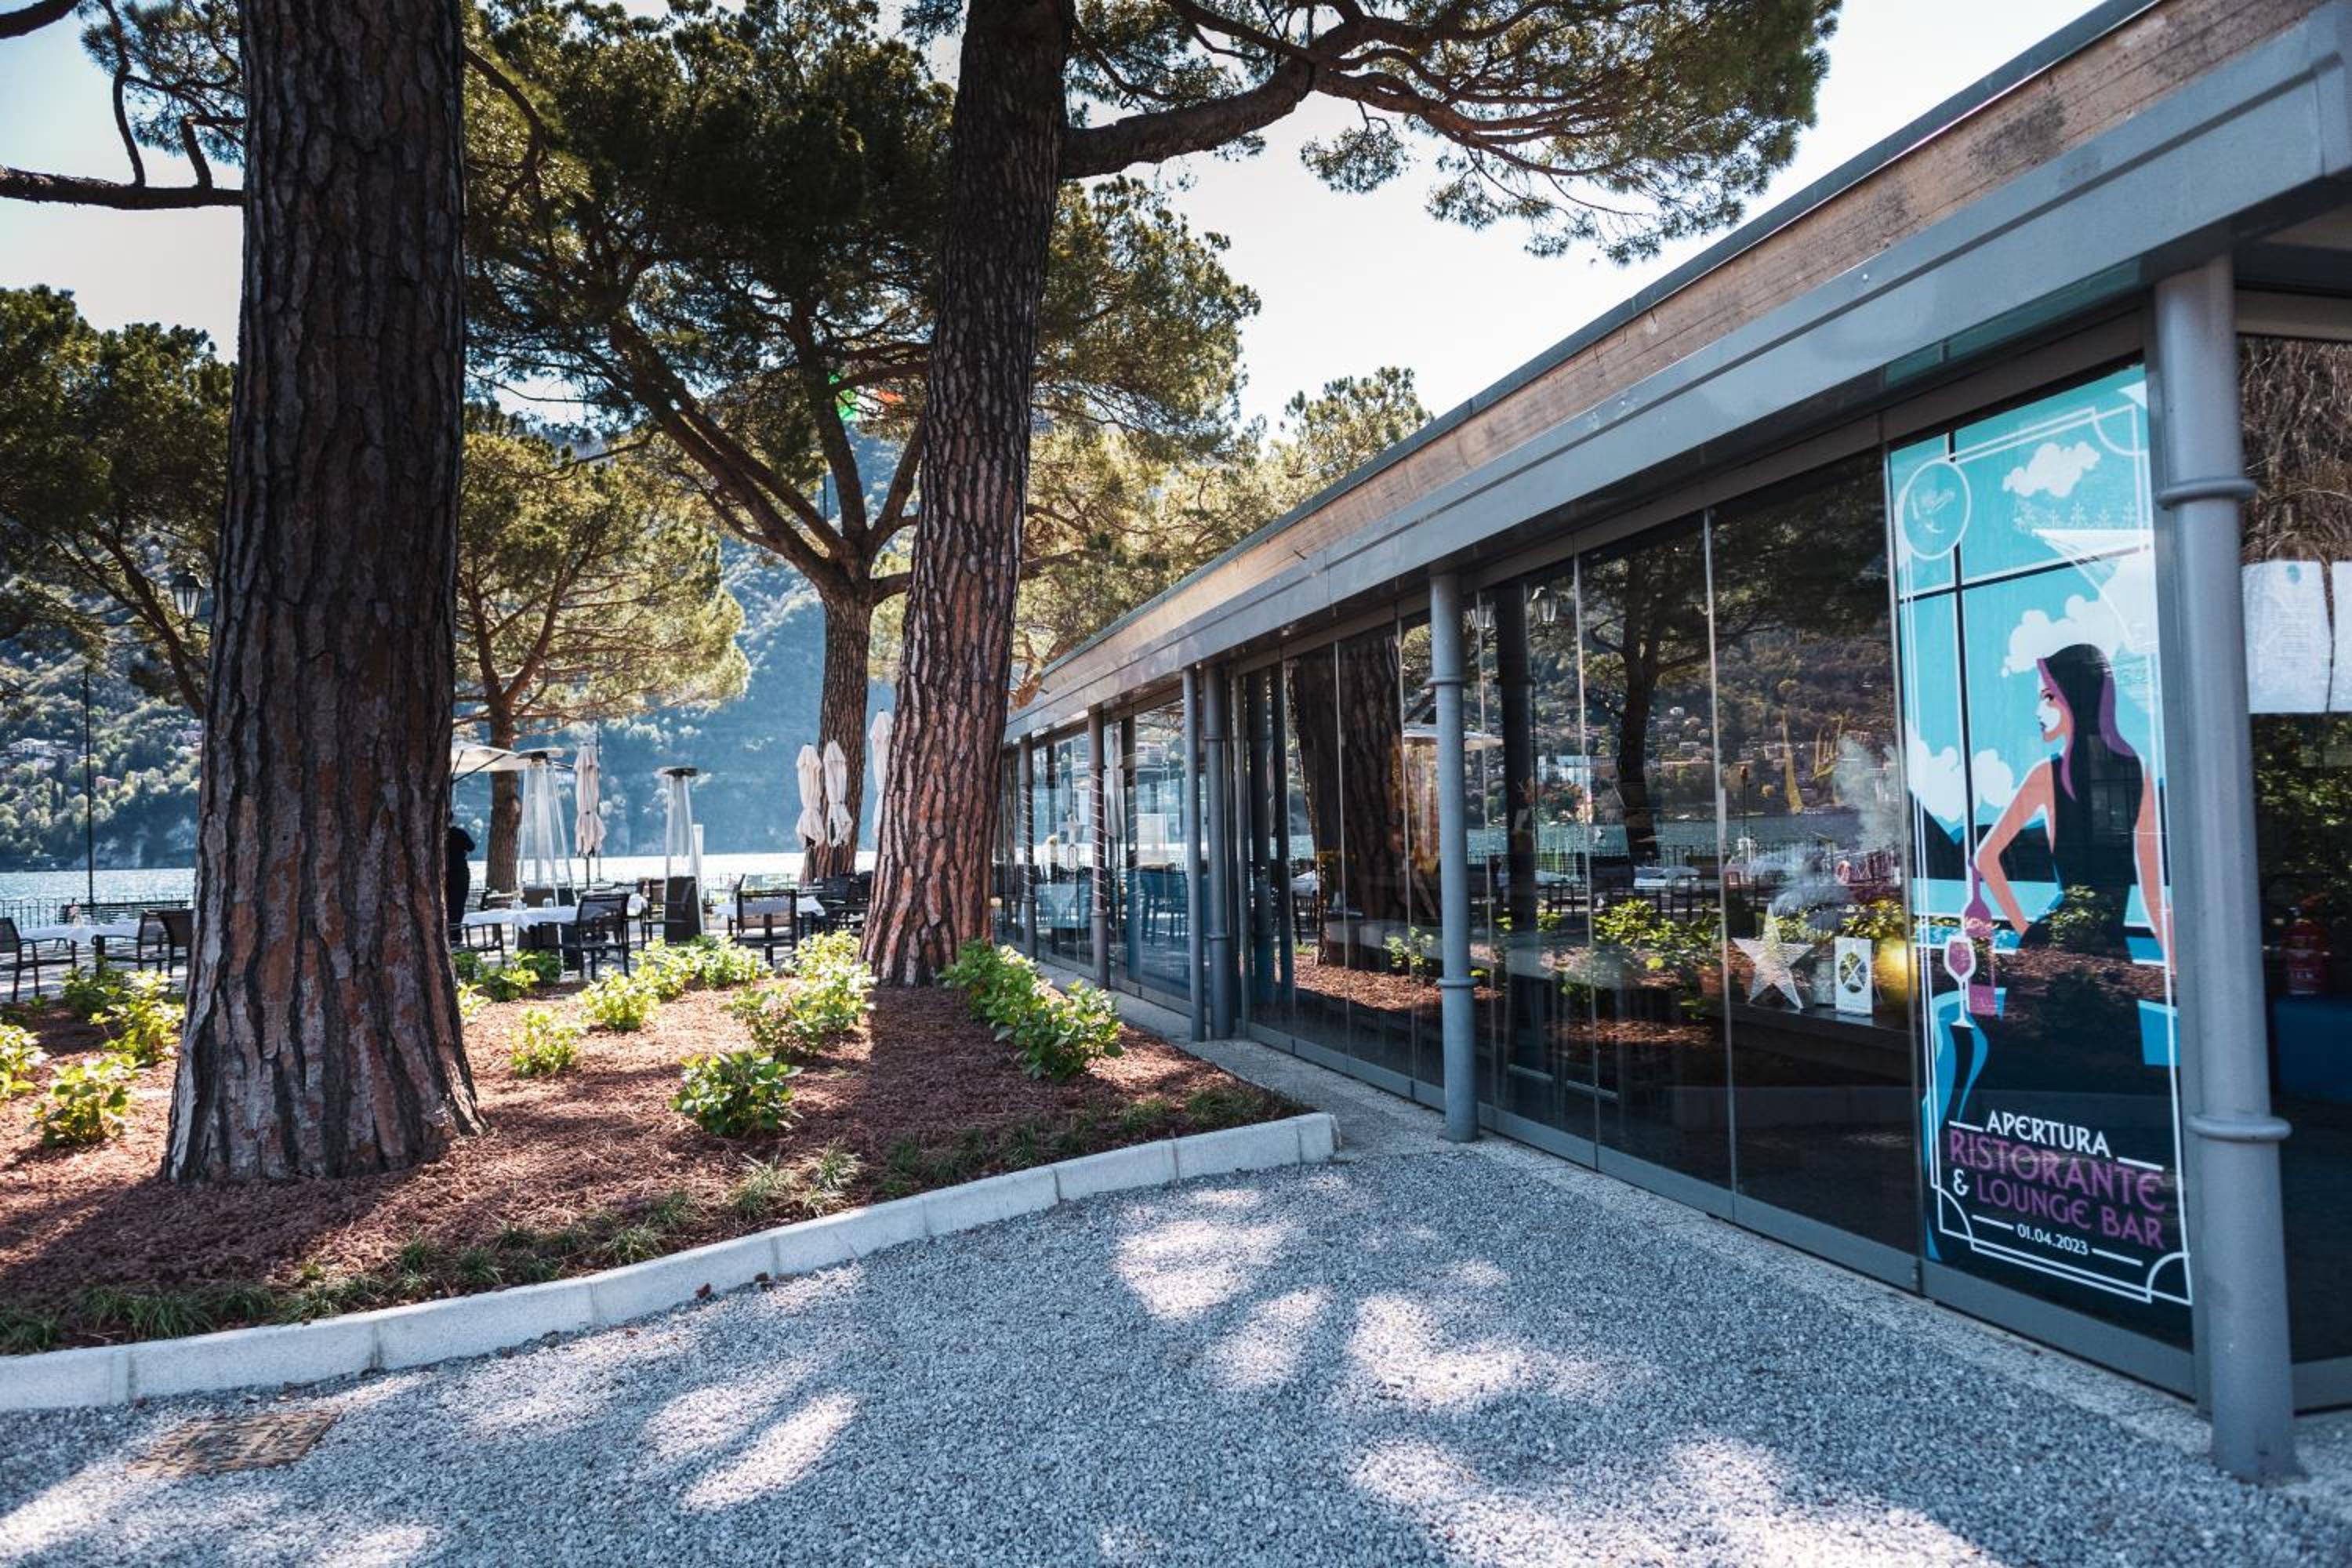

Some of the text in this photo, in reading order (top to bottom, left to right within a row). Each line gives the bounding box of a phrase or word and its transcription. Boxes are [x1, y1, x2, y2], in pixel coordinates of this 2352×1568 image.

[1986, 1109, 2111, 1158] APERTURA
[1949, 1129, 2165, 1211] RISTORANTE
[1953, 1169, 2165, 1249] & LOUNGE BAR
[2017, 1224, 2089, 1254] 01.04.2023
